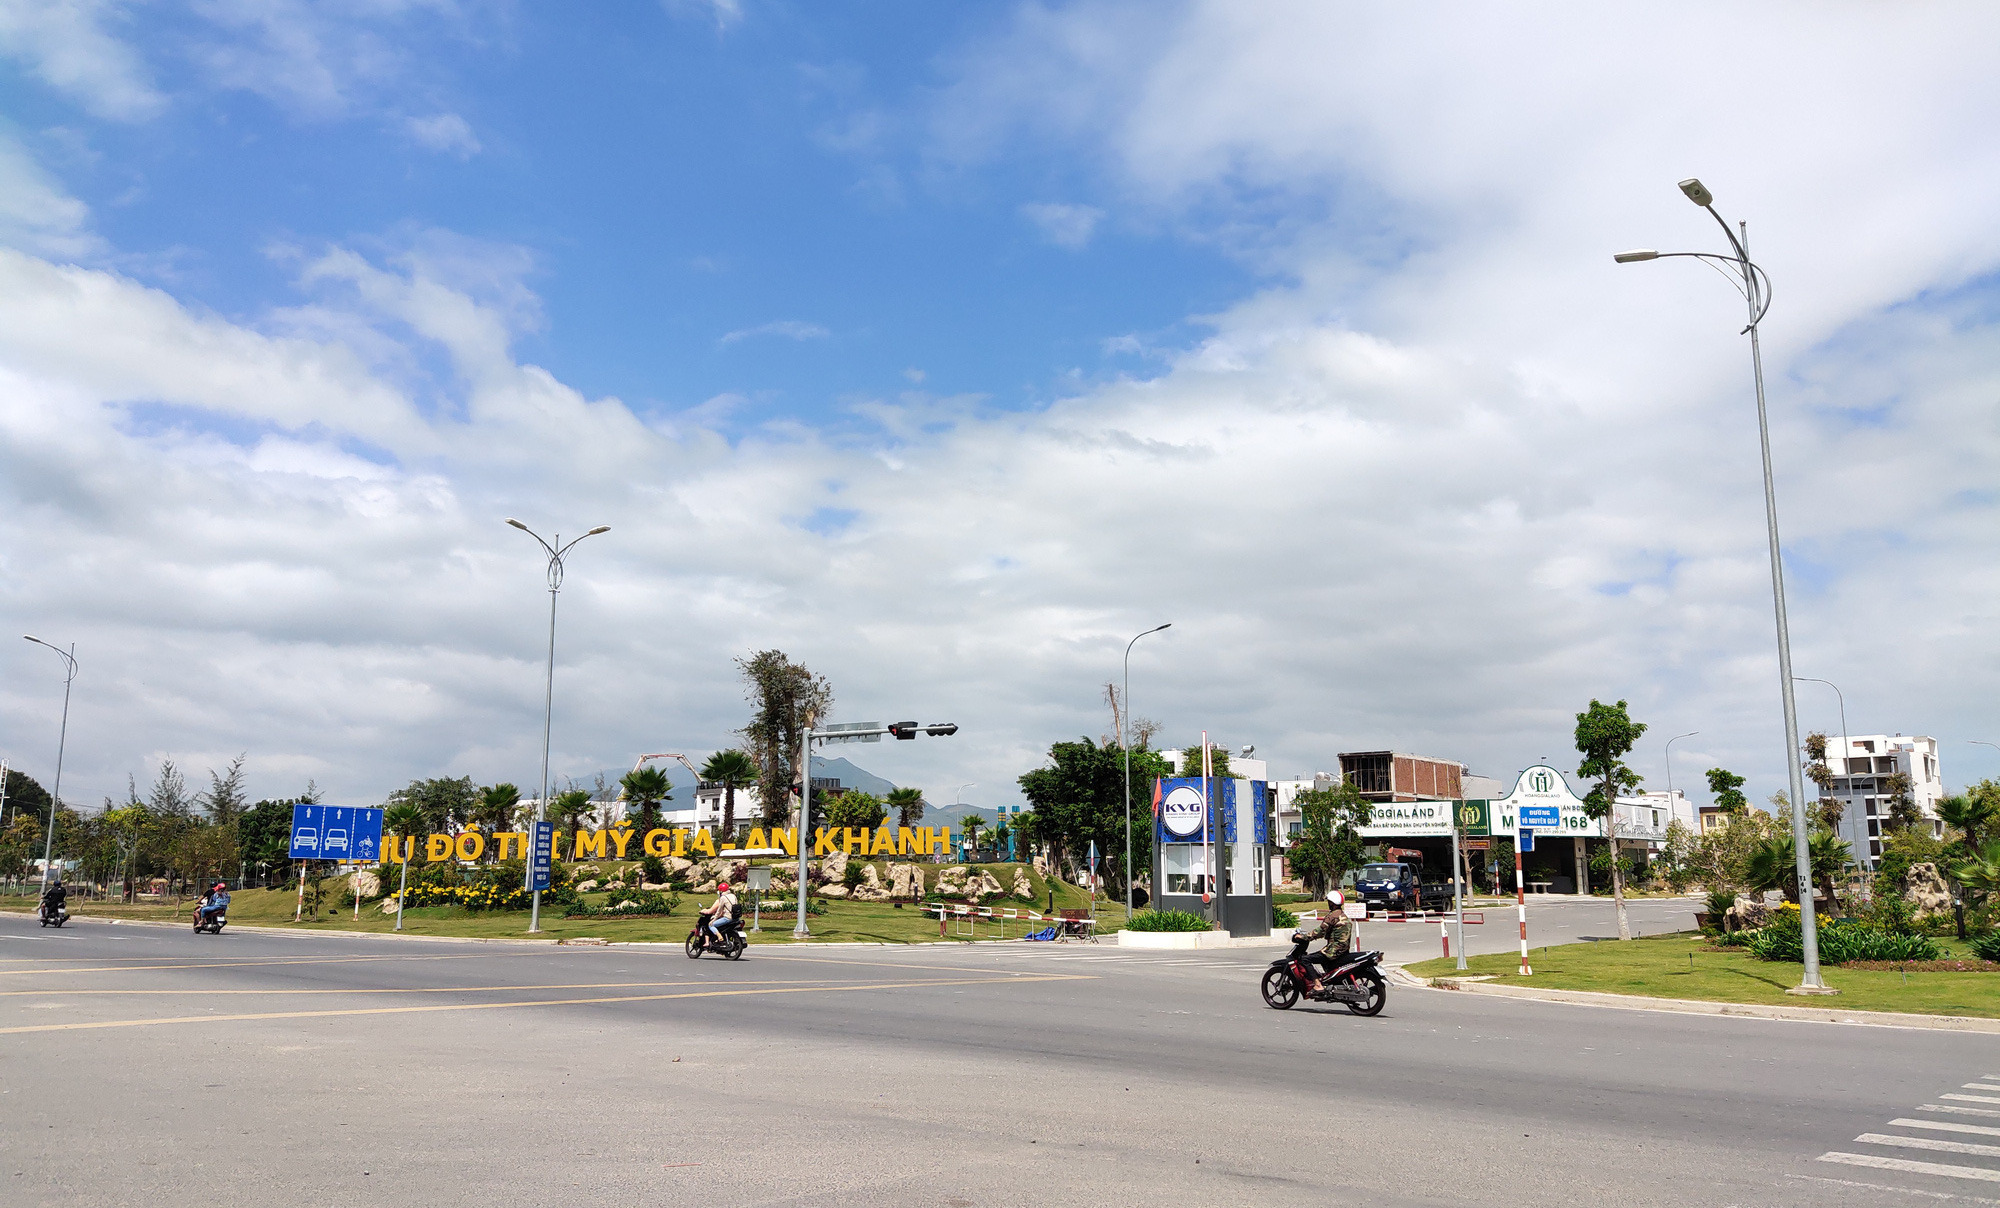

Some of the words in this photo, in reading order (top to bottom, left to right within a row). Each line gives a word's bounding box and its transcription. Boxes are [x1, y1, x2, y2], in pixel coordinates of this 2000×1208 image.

[1166, 803, 1200, 812] KVG
[1563, 816, 1588, 828] 168
[425, 824, 485, 861] ĐÔ
[575, 819, 635, 858] MỸ
[643, 828, 716, 857] GIA
[745, 827, 797, 856] AN
[814, 817, 951, 856] KHÁNH
